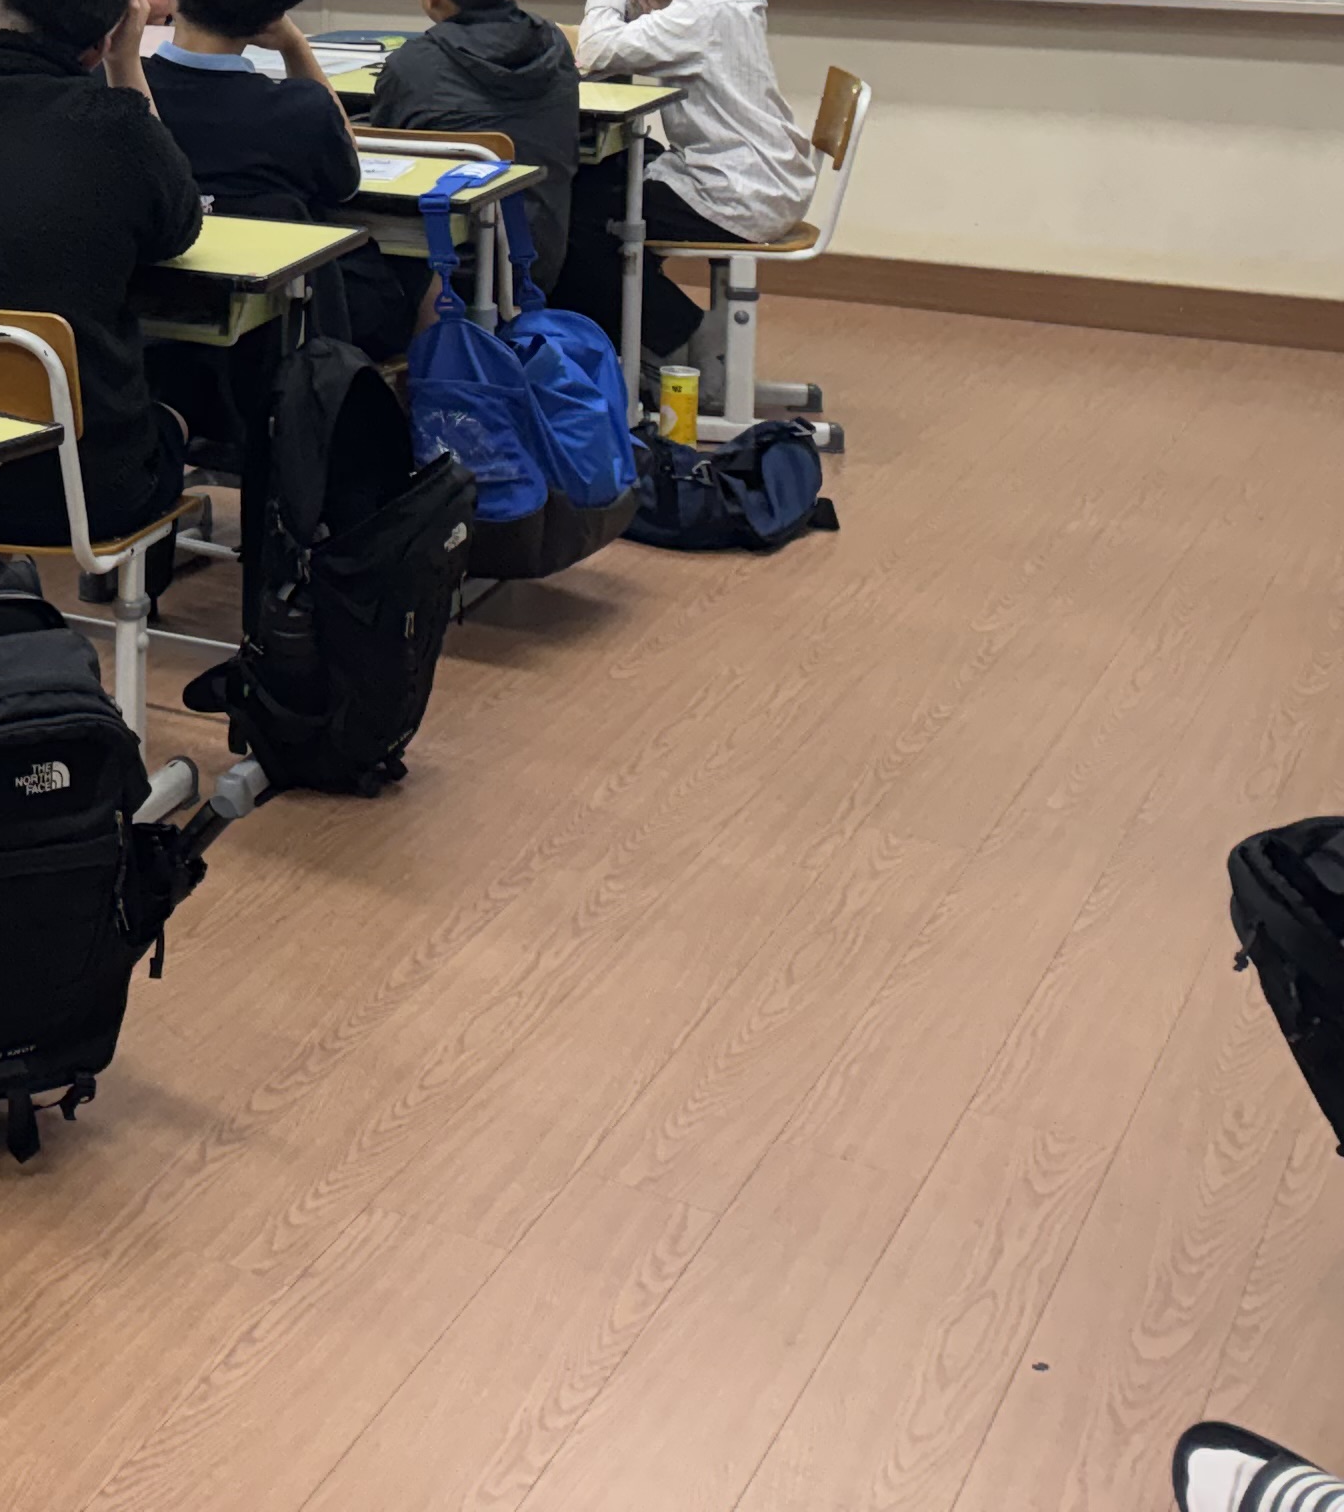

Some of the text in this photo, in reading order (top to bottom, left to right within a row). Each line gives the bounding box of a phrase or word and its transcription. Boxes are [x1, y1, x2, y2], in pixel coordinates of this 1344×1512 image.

[32, 762, 52, 774] THE
[15, 772, 52, 787] NORTH
[26, 783, 52, 796] FACE
